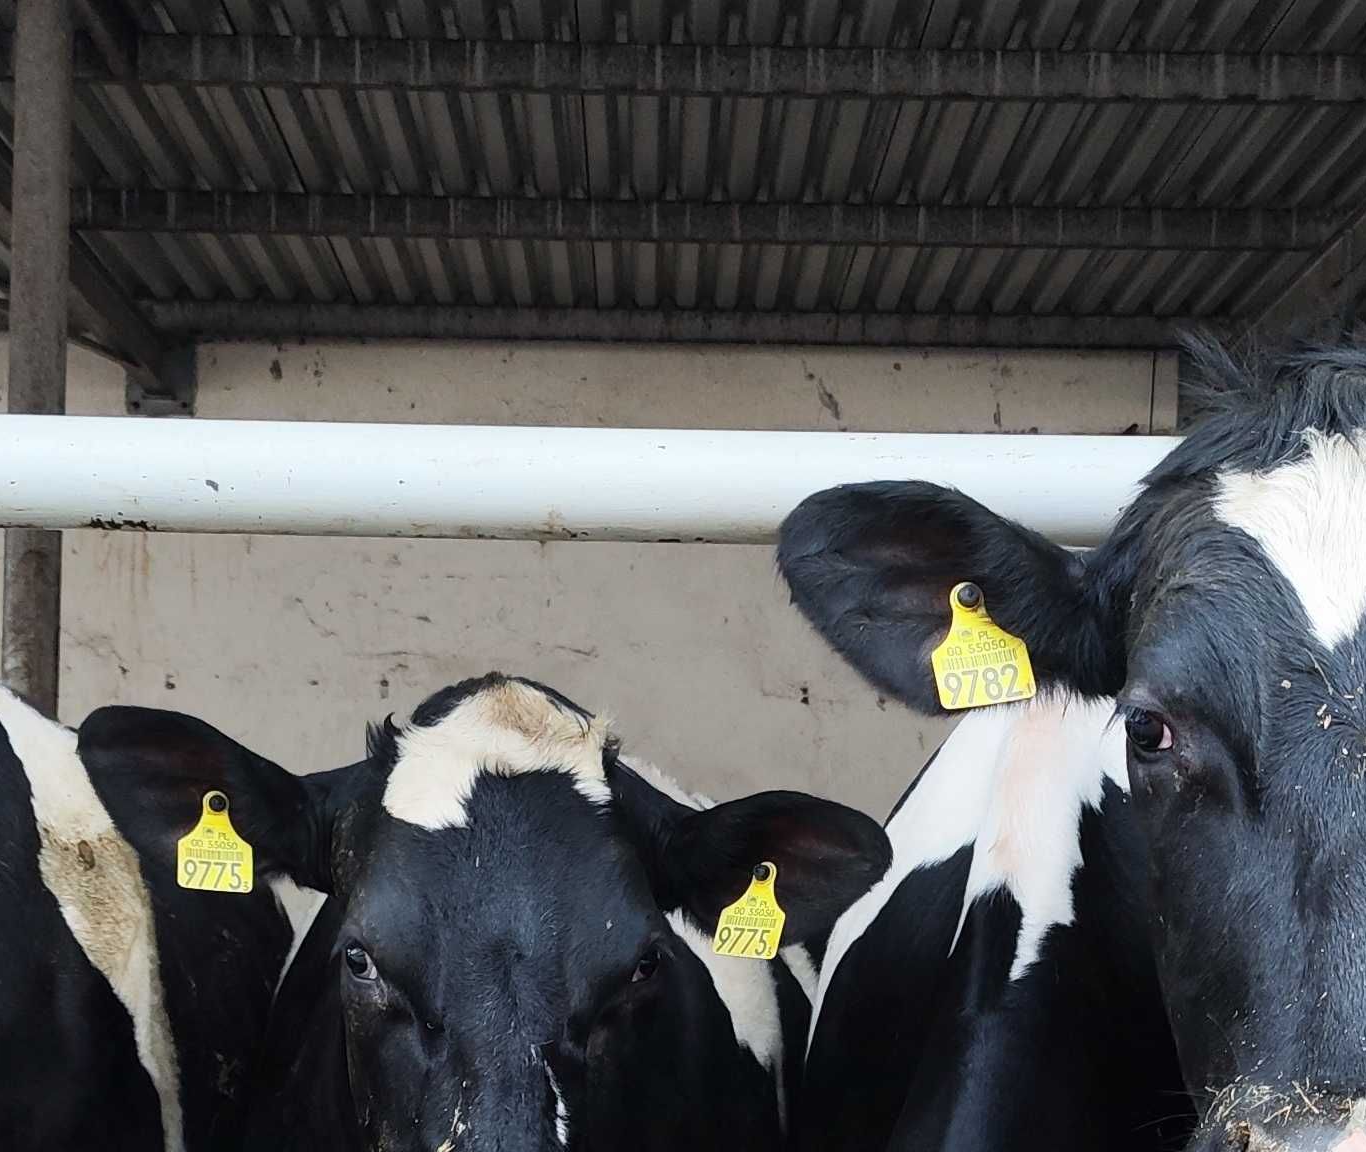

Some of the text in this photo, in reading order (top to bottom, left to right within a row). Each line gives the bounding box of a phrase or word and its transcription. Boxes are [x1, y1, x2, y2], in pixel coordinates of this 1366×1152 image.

[978, 631, 994, 641] PL
[944, 663, 1020, 706] 9782
[184, 859, 242, 890] 9775
[716, 926, 771, 956] 9775
